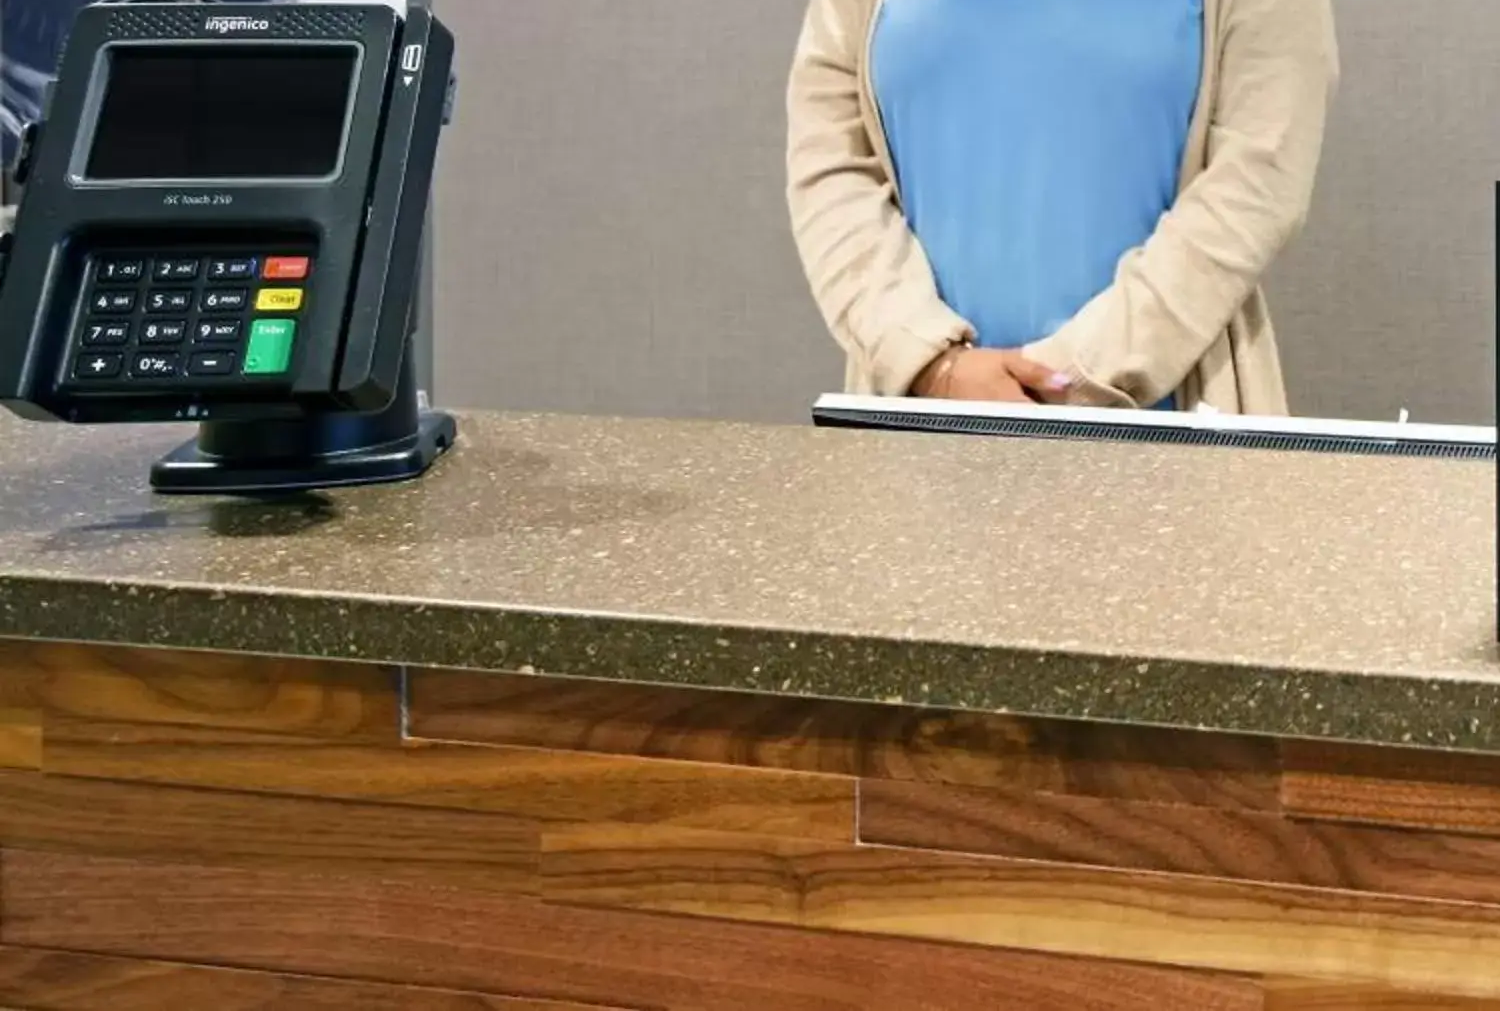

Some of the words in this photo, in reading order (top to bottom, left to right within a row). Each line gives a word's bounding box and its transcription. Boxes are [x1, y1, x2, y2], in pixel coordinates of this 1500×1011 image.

[204, 15, 270, 34] ingenico
[107, 264, 115, 277] 1
[161, 264, 172, 276] 2
[214, 262, 226, 274] 3
[97, 295, 108, 307] 4
[152, 294, 164, 307] 5
[206, 293, 218, 306] 6
[91, 326, 102, 338] 7
[146, 325, 157, 338] 8
[201, 325, 212, 337] 9
